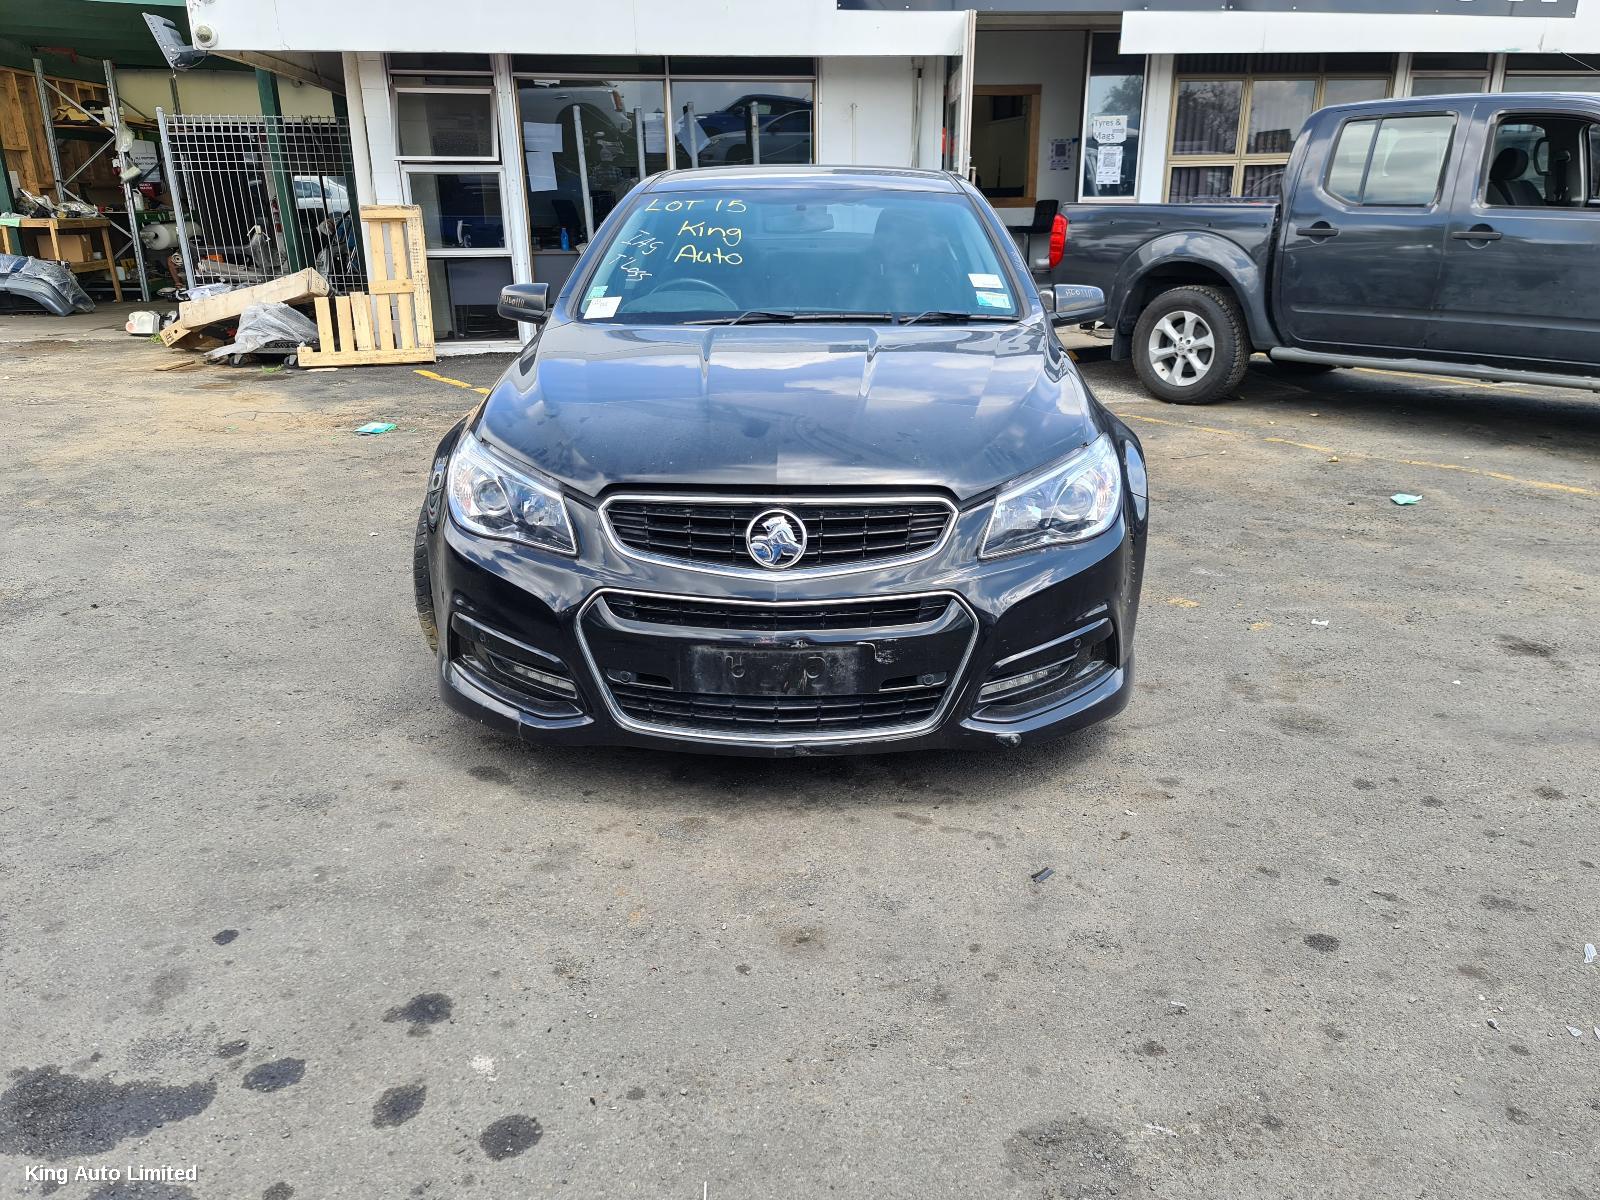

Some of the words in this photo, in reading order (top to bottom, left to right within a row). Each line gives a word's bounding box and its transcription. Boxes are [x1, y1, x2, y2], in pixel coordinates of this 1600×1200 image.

[1095, 120, 1114, 128] Tyres
[1115, 118, 1121, 126] &
[1095, 132, 1115, 141] Mags
[645, 198, 704, 212] LOT
[715, 199, 747, 213] 15
[677, 220, 742, 247] King
[674, 244, 743, 265] Auto
